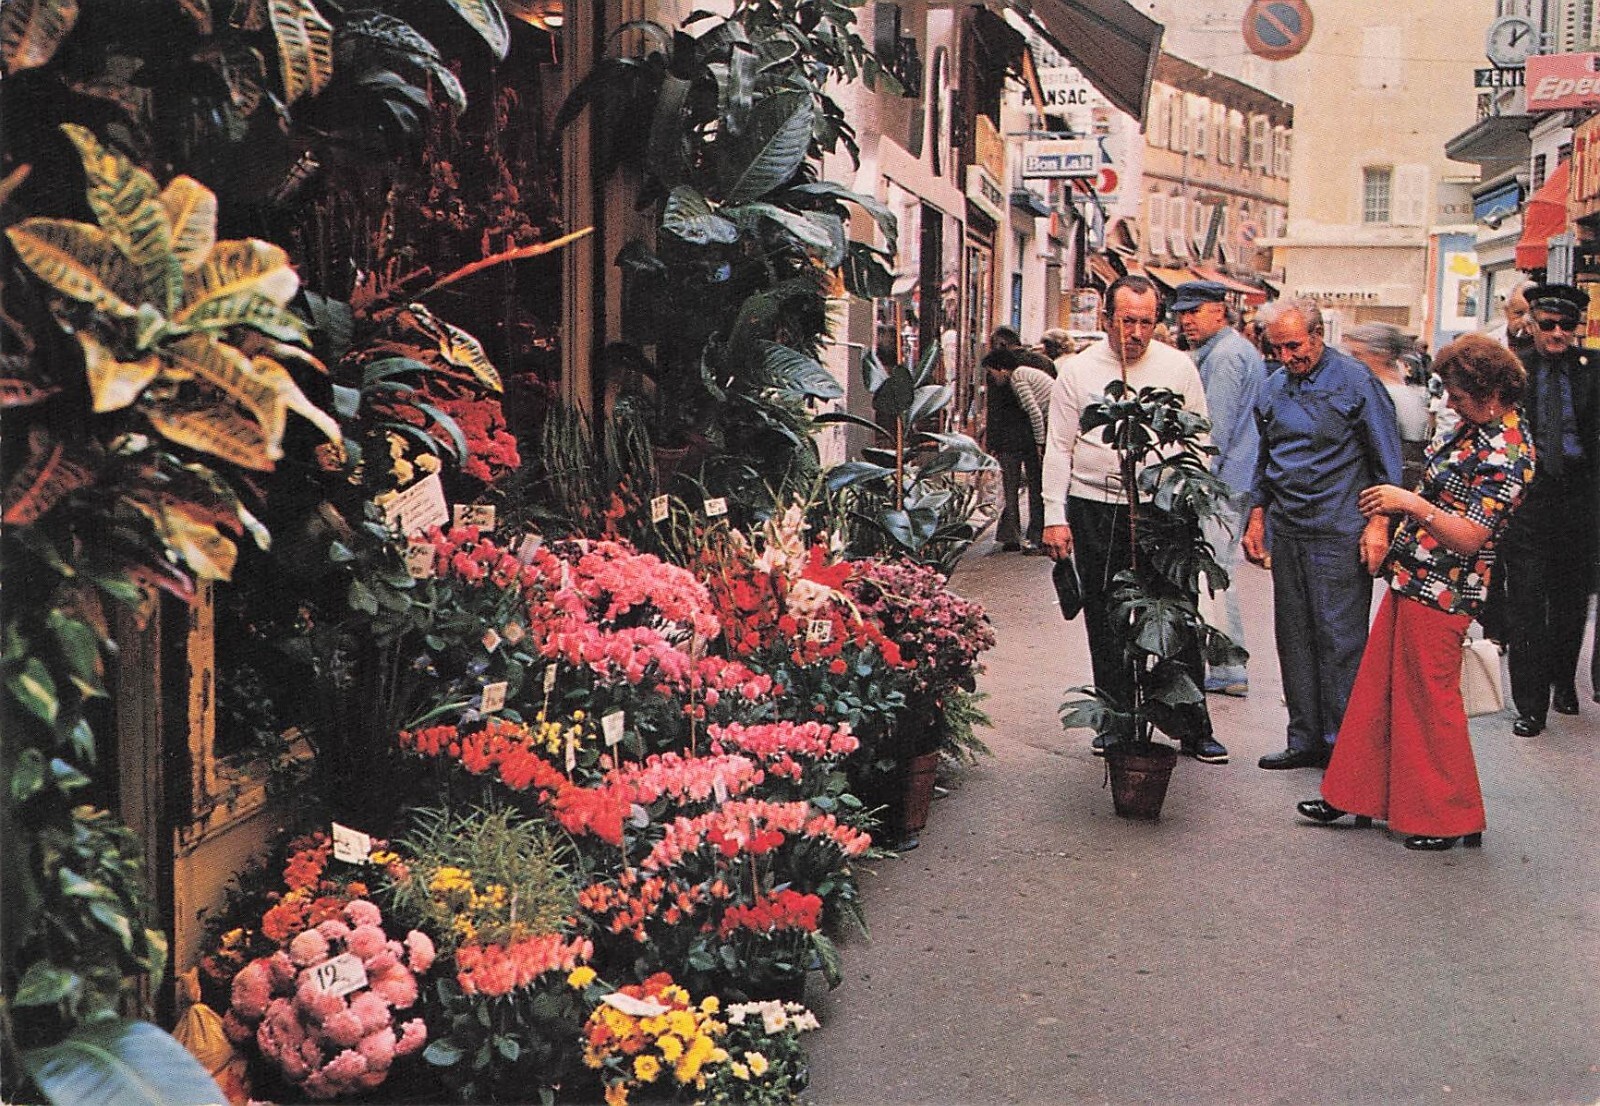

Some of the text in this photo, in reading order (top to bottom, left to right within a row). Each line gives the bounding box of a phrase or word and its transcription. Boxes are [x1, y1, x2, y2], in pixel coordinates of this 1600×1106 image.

[1480, 69, 1525, 87] ZENI
[1022, 88, 1087, 106] MNSAC
[1028, 155, 1091, 170] Bon Lait
[317, 964, 337, 990] 12
